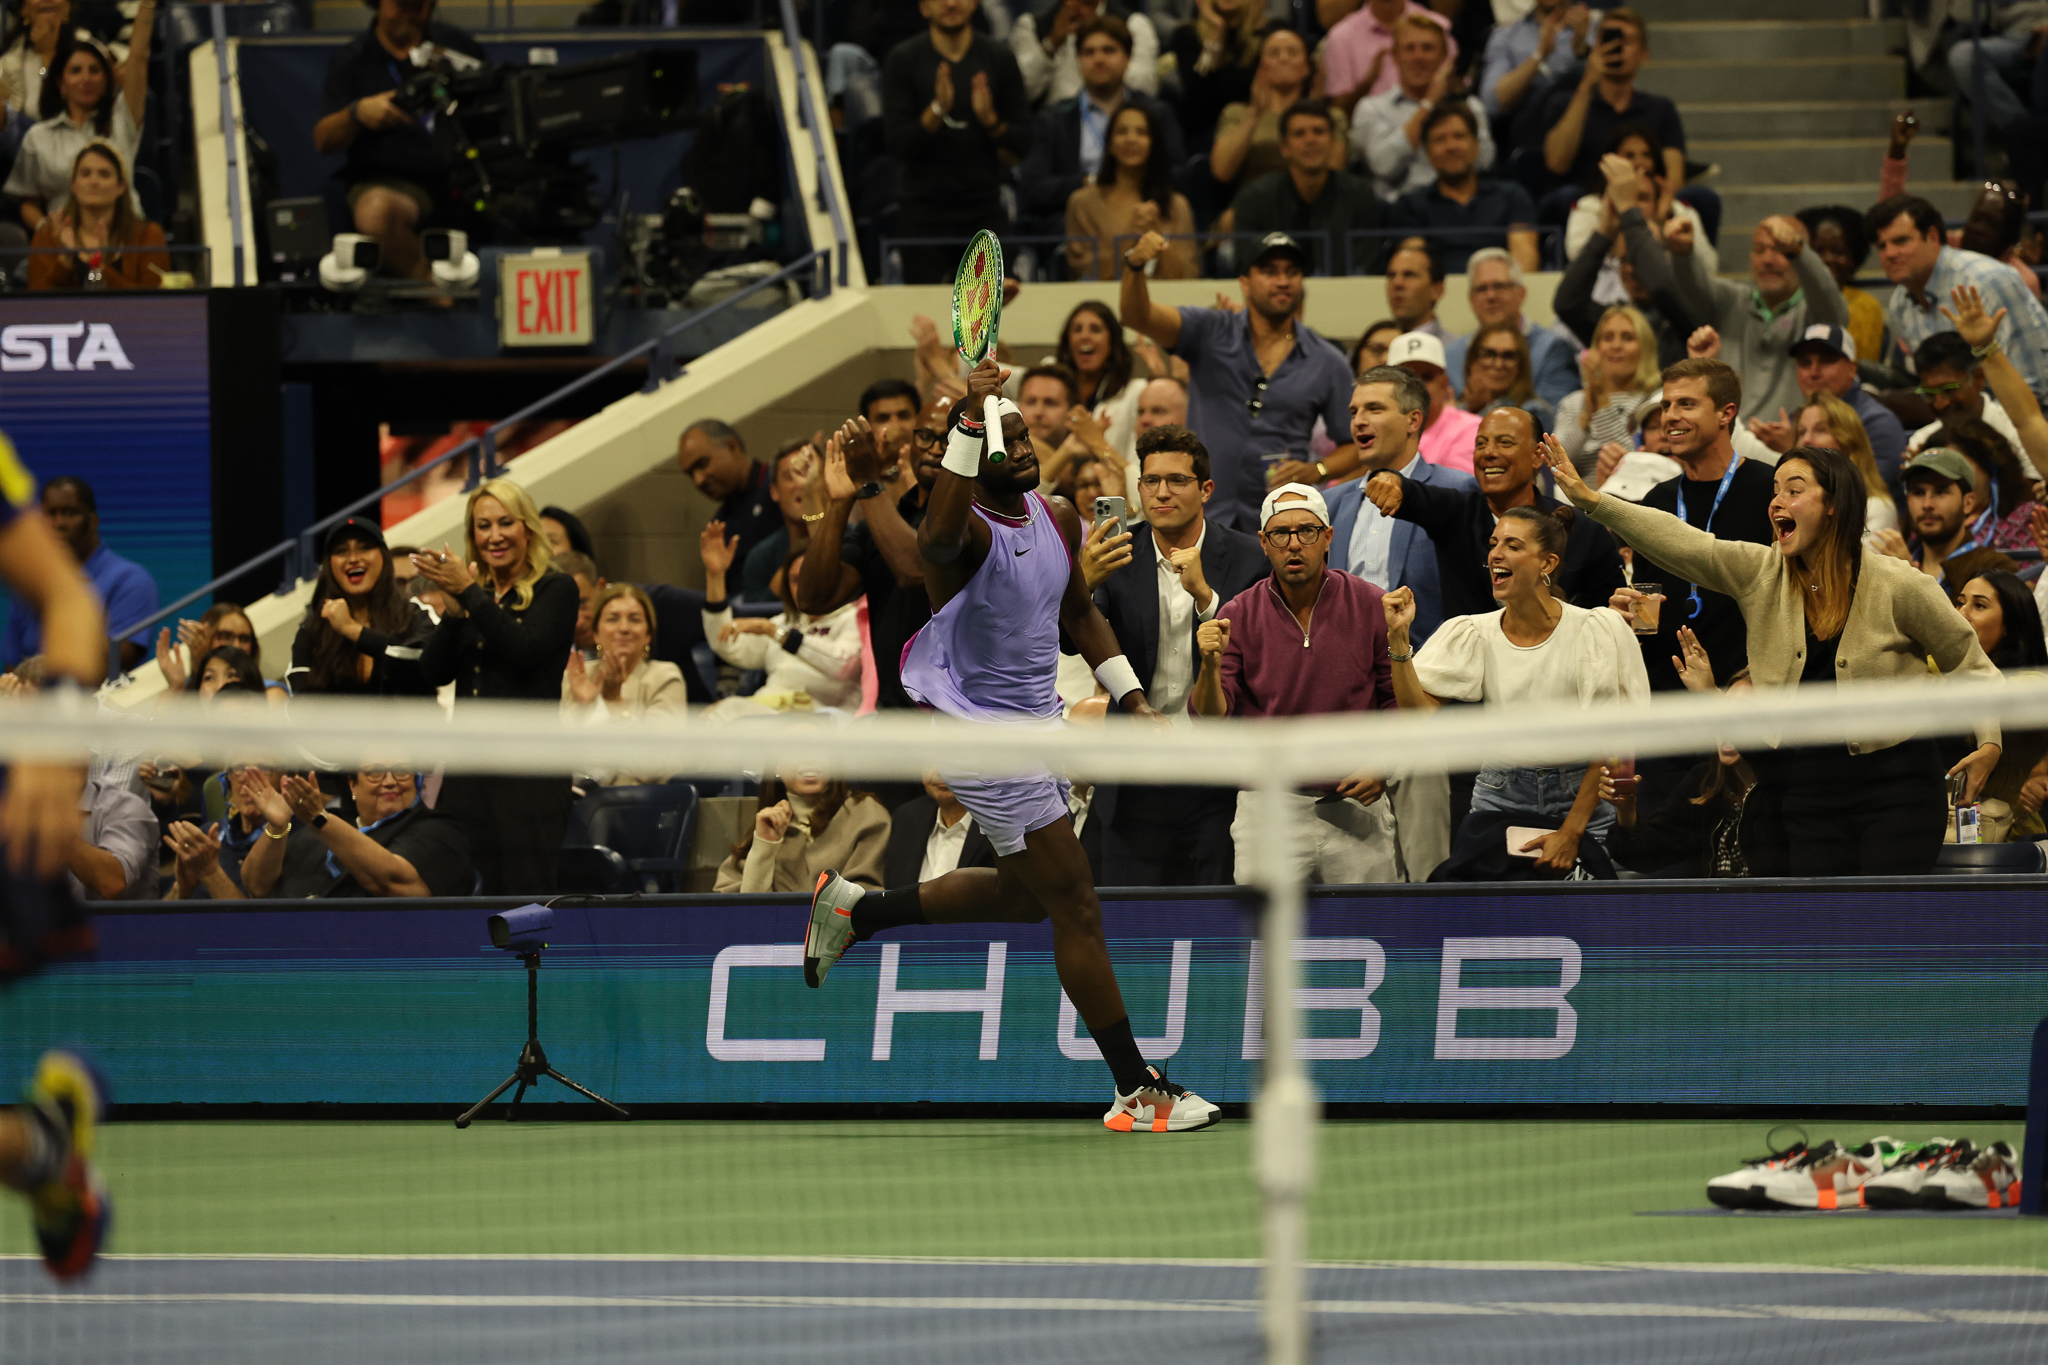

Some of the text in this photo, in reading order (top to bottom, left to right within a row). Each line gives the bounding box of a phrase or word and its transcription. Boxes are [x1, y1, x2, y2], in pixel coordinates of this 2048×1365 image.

[516, 269, 580, 334] EXIT
[1, 320, 135, 372] STA
[1408, 338, 1422, 355] P
[706, 936, 1582, 1061] CHUBB
